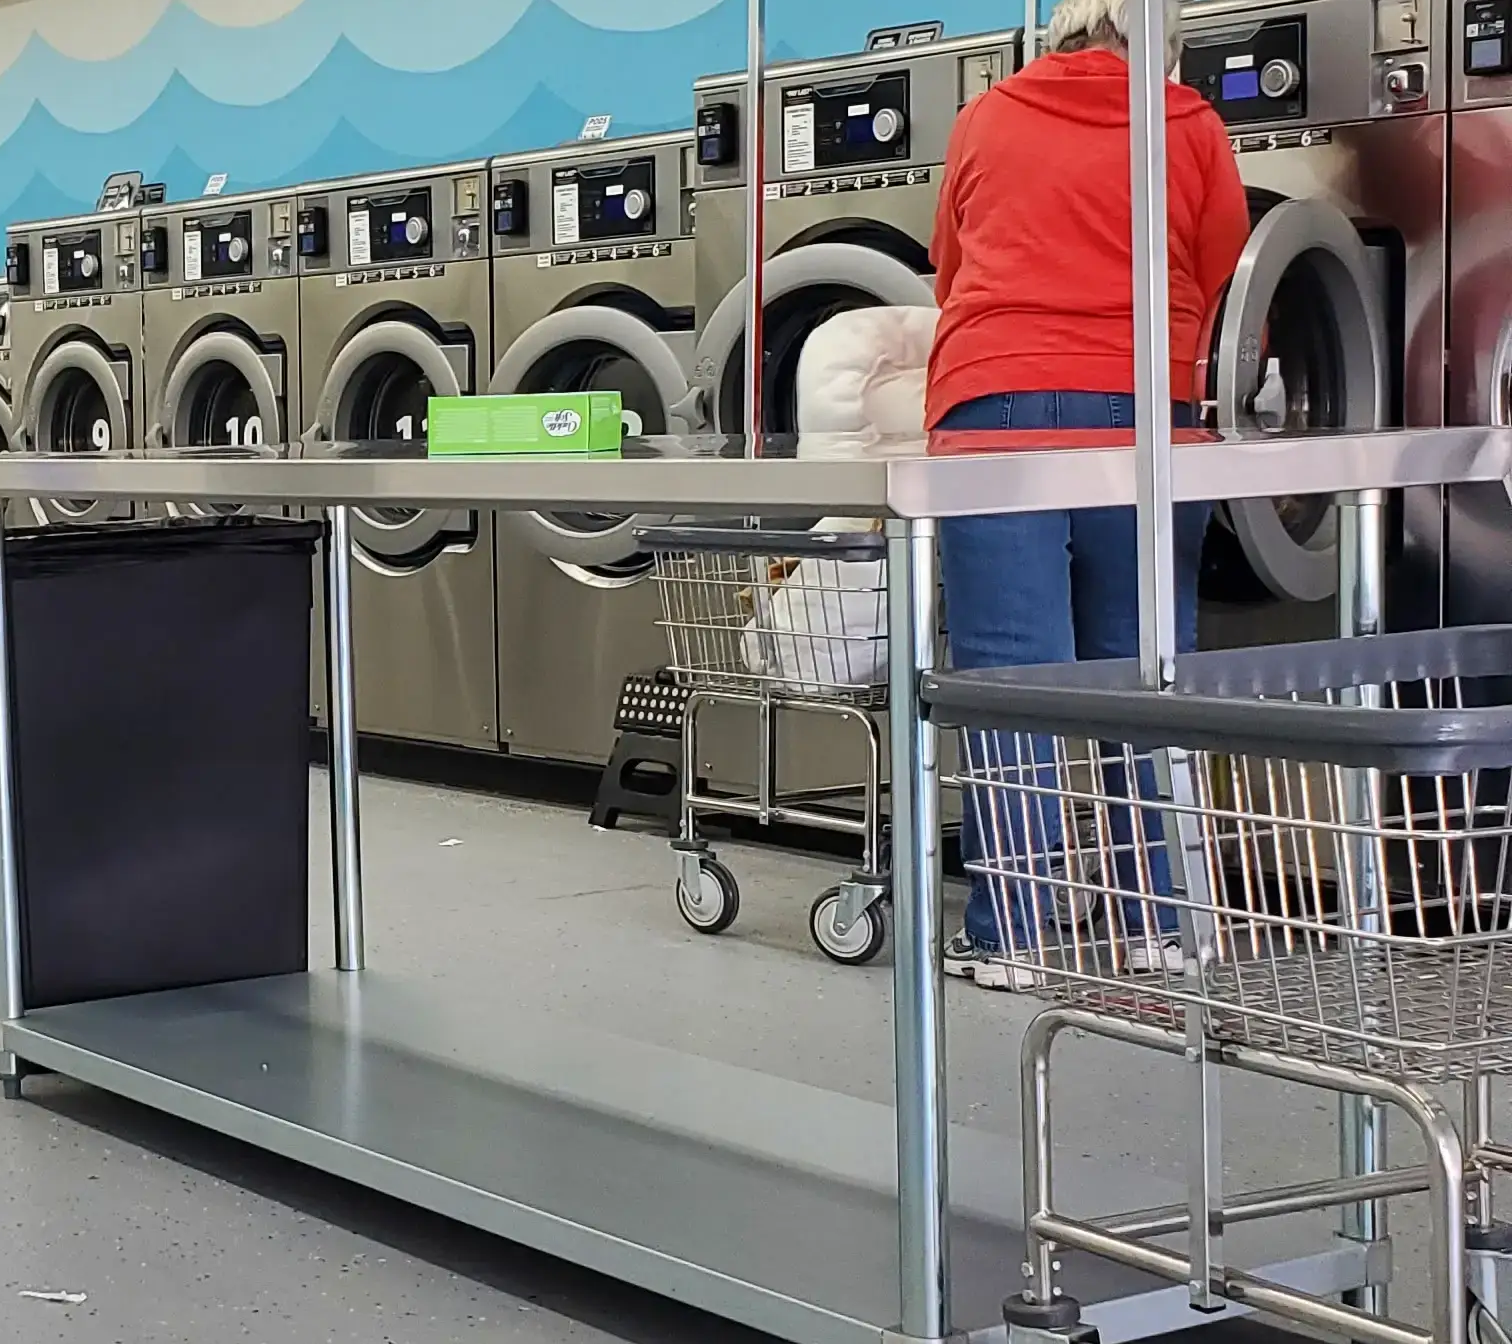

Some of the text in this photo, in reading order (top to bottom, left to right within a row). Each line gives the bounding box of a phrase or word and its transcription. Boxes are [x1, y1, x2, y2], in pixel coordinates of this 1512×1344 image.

[1232, 131, 1312, 153] 4 5 6
[781, 185, 787, 198] 1
[804, 182, 813, 196] 2
[829, 179, 838, 193] 3
[853, 177, 861, 191] 4
[881, 174, 889, 188] 5
[906, 171, 915, 184] 6
[570, 252, 577, 263] 2
[591, 250, 598, 261] 3
[652, 244, 660, 256] 6
[92, 419, 110, 452] 9
[226, 416, 263, 446] 10
